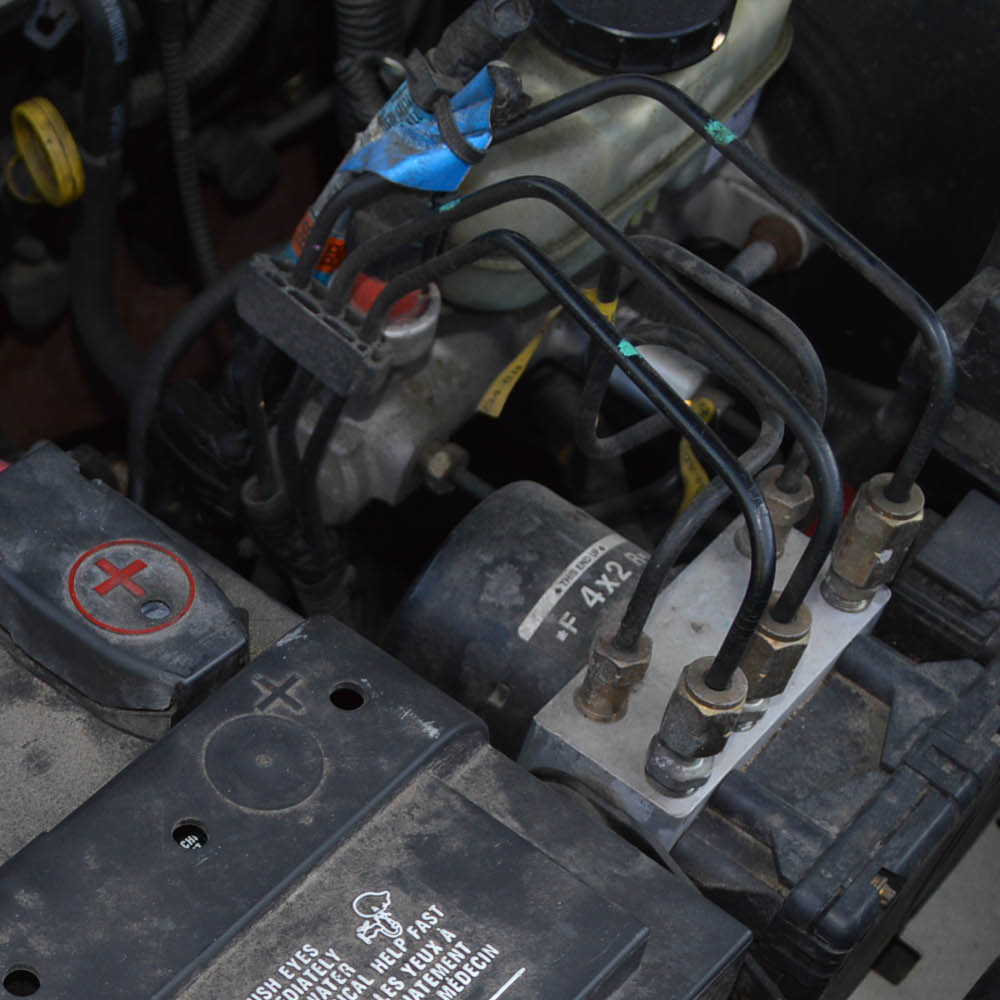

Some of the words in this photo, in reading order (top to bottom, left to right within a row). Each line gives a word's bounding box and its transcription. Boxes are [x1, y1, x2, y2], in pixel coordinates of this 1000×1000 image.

[580, 561, 632, 608] 4x2
[277, 942, 320, 980] EYES
[369, 936, 409, 974] HELP
[405, 903, 445, 940] FAST
[399, 939, 444, 978] YEUX
[435, 925, 457, 943] À
